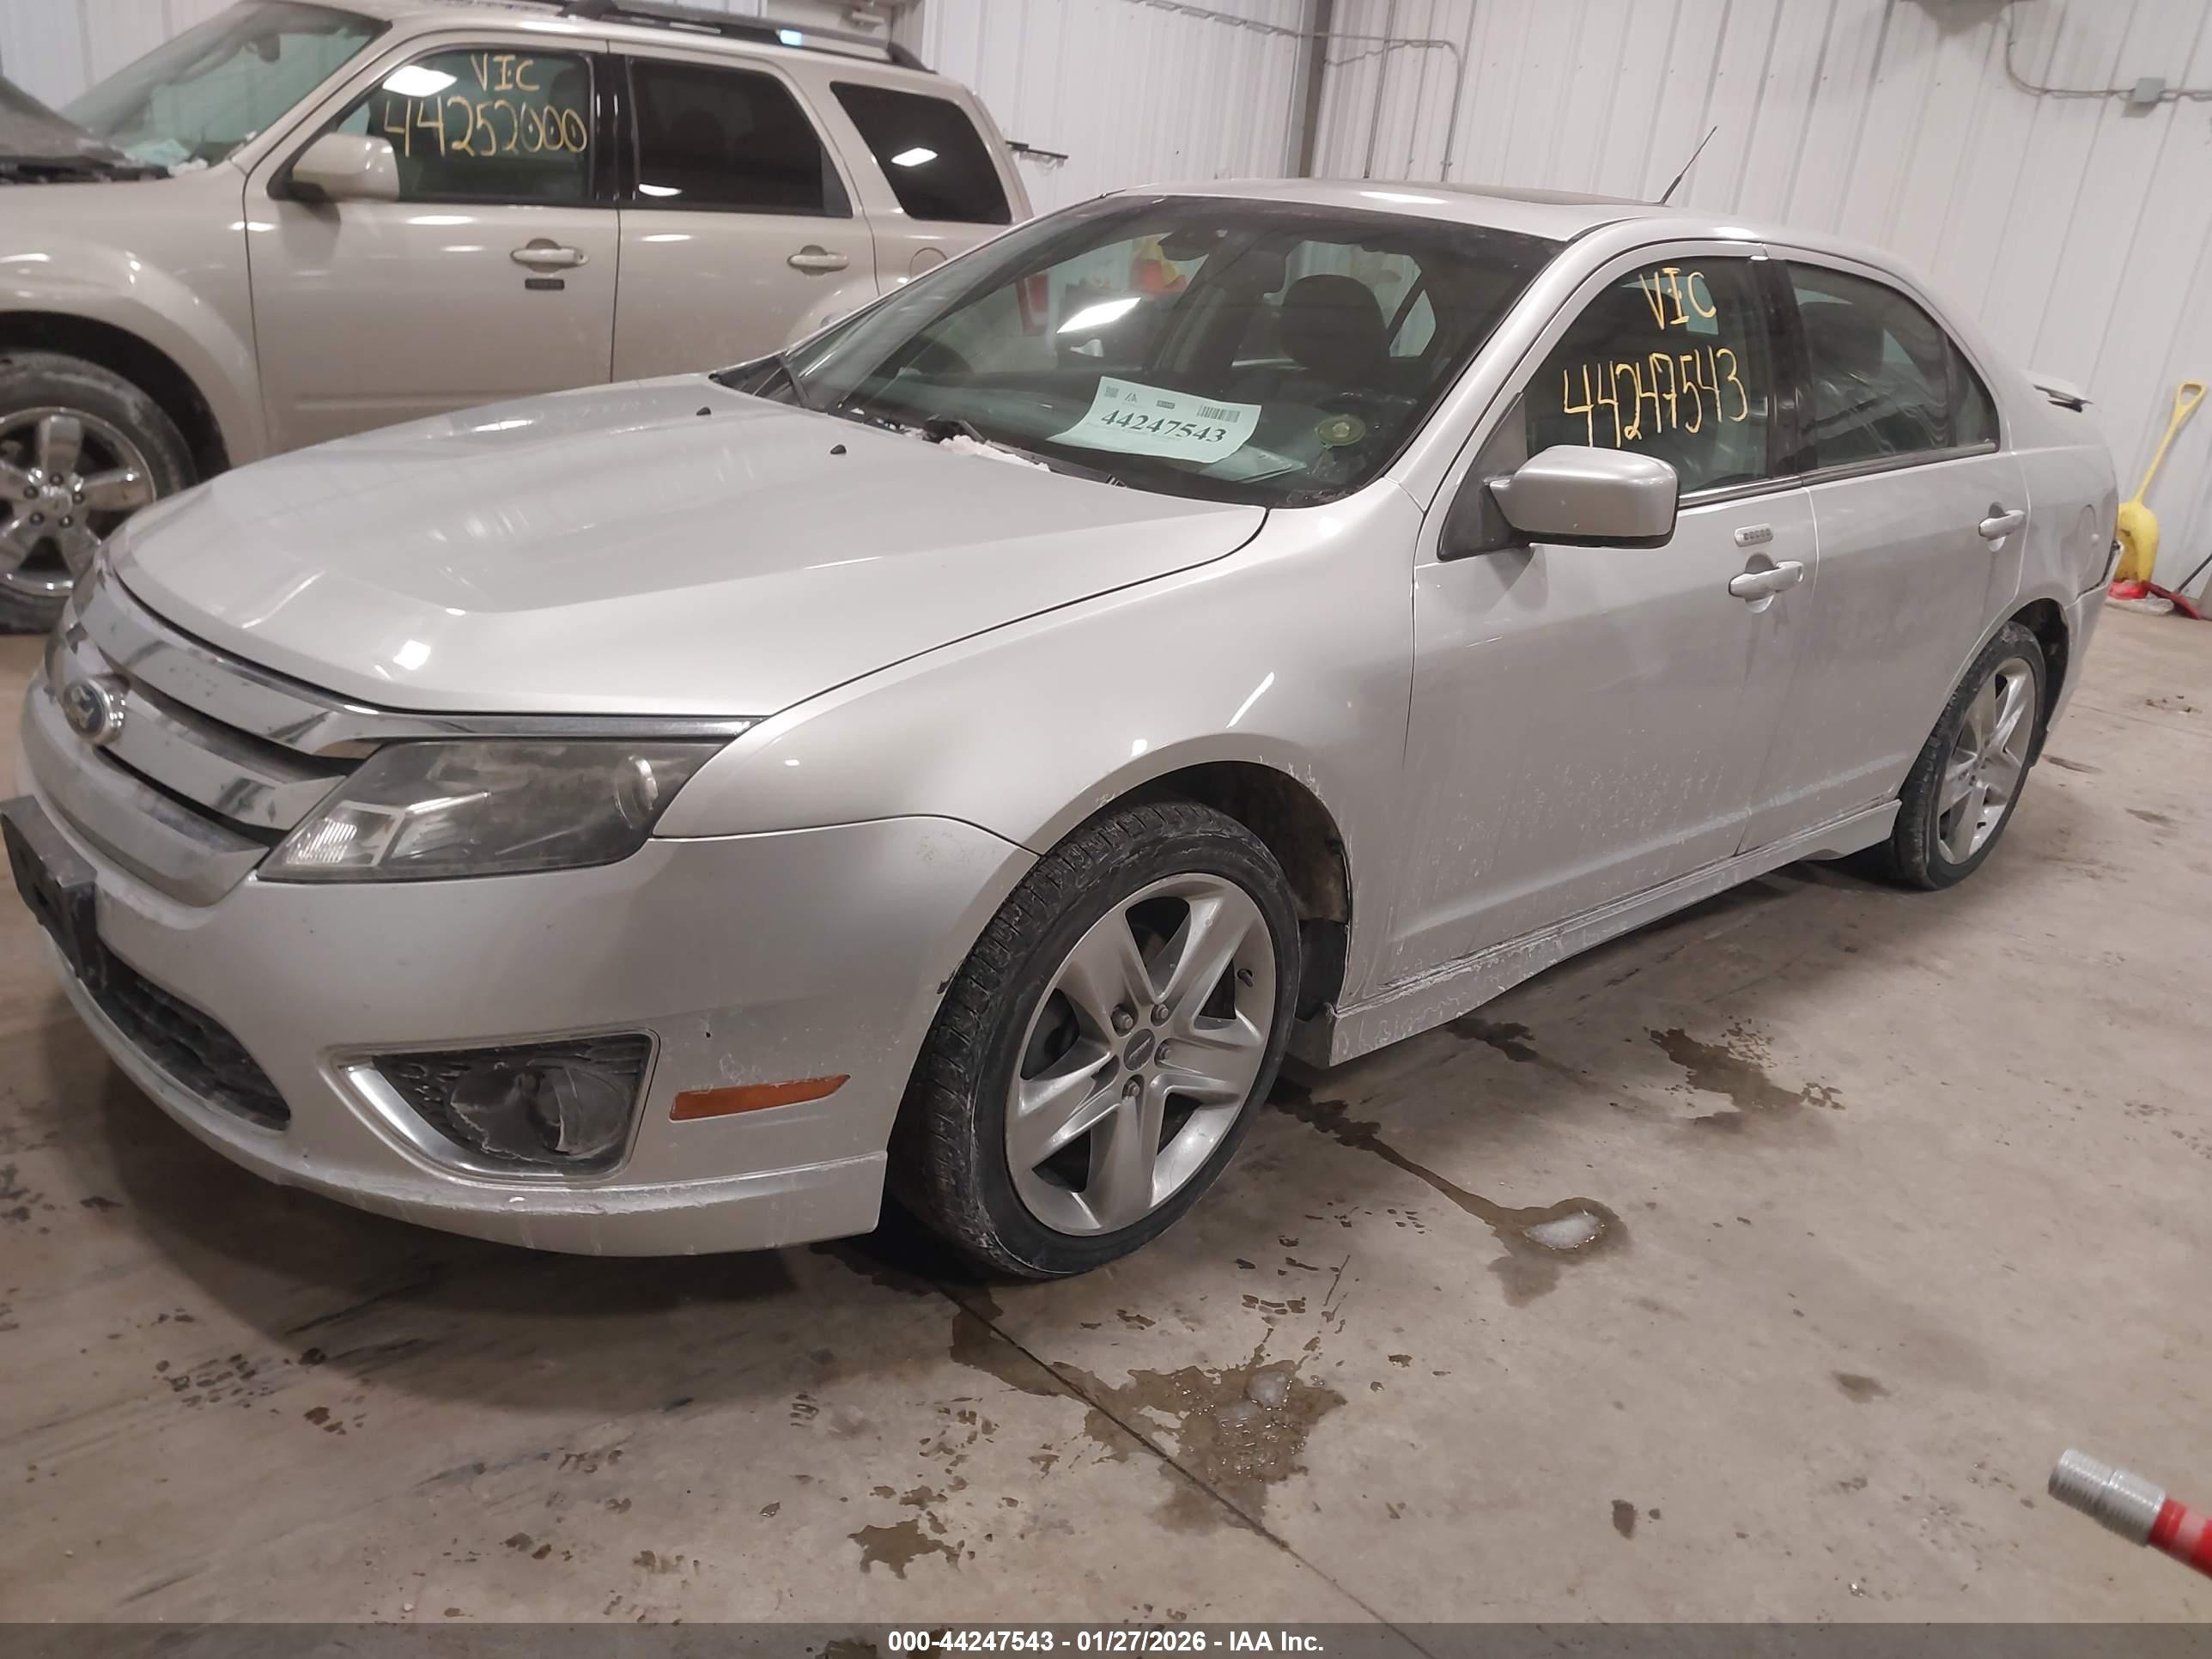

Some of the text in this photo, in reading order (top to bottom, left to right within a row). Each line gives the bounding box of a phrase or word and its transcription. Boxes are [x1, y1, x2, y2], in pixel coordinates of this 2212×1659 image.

[470, 52, 540, 91] VIC
[383, 95, 588, 158] 44252000
[1639, 267, 1717, 331] VIC
[1101, 410, 1226, 443] 44247543
[1564, 345, 1748, 448] 44247543
